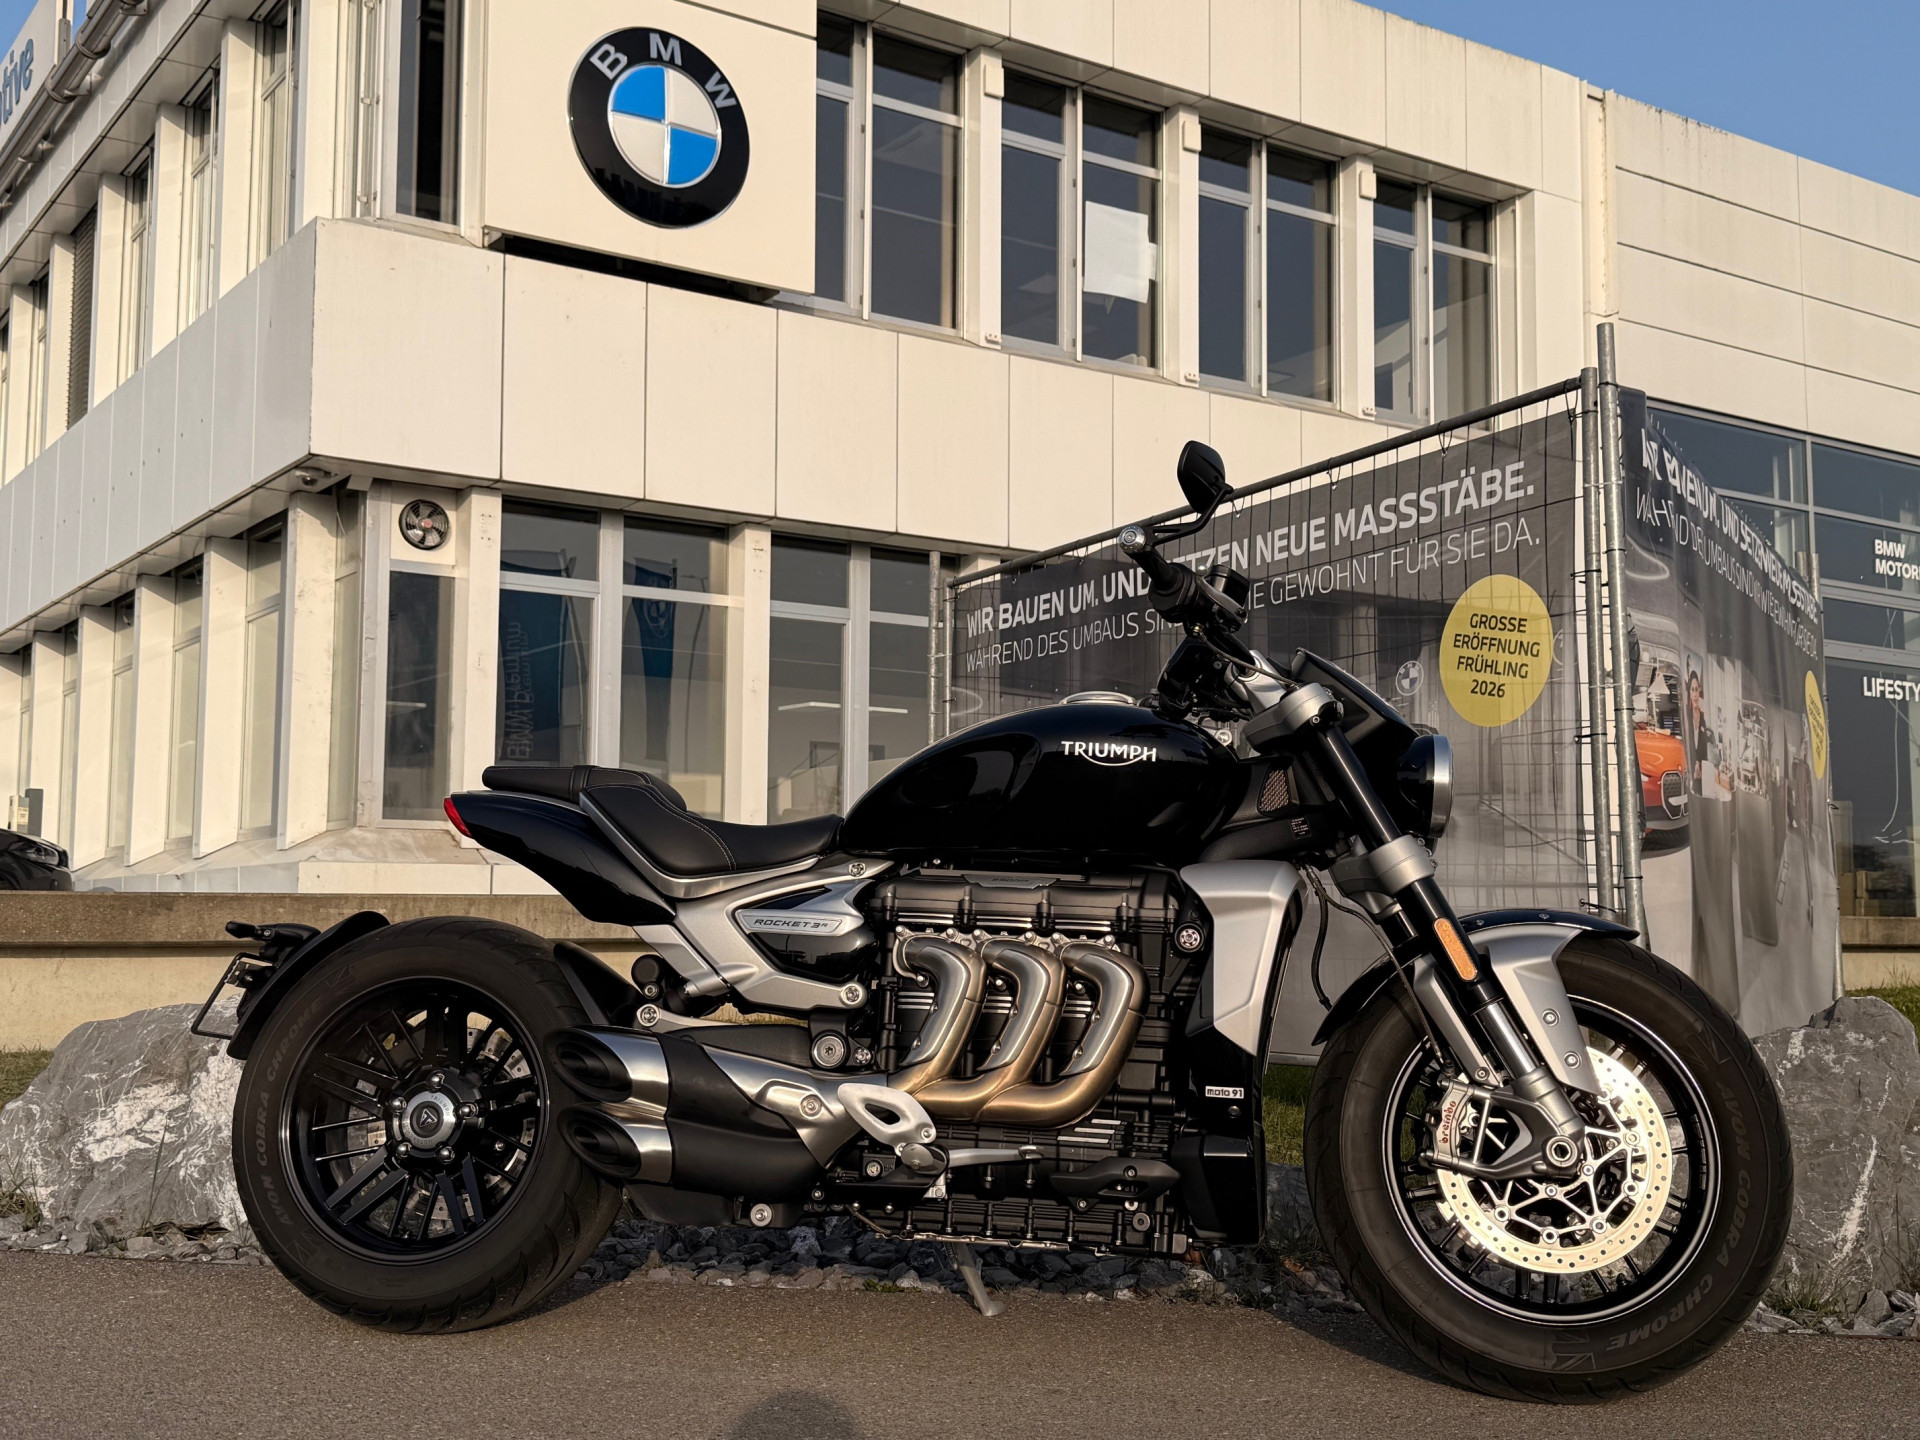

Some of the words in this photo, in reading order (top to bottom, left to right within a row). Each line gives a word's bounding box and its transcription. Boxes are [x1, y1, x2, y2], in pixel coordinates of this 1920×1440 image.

[0, 38, 34, 131] tive
[589, 32, 737, 109] BMW
[966, 606, 994, 639] WIR
[998, 589, 1065, 631] BAUEN
[1069, 580, 1099, 614] UM.
[1102, 567, 1151, 603] UND
[1255, 516, 1326, 566] NEUE
[1334, 460, 1535, 546] MASSSTÄBE.
[1874, 538, 1906, 559] BMW
[1875, 558, 1920, 581] MOTOR
[966, 637, 1034, 673] WÄHREND
[1037, 629, 1069, 658] DES
[1072, 611, 1140, 651] UMBAUS
[1269, 551, 1385, 605] GEWOHNT
[1390, 537, 1440, 578] FÜR
[1446, 526, 1486, 565] SIE
[1494, 516, 1540, 554] DA.
[1452, 632, 1541, 658] ERÖFFNUNG
[1469, 613, 1528, 634] GROSSE
[1456, 655, 1529, 679] FRÜHLING
[1470, 679, 1506, 698] 2026
[1061, 740, 1157, 766] TRIUMPH
[753, 918, 811, 928] ROCKET
[1231, 1089, 1243, 1098] 91
[255, 1091, 270, 1167] COBRA
[1438, 1100, 1457, 1144] brembo
[1716, 1081, 1752, 1162] AVON
[261, 1174, 294, 1226] AVON
[1716, 1168, 1751, 1268] COBRA
[1605, 1273, 1713, 1352] CHROME
